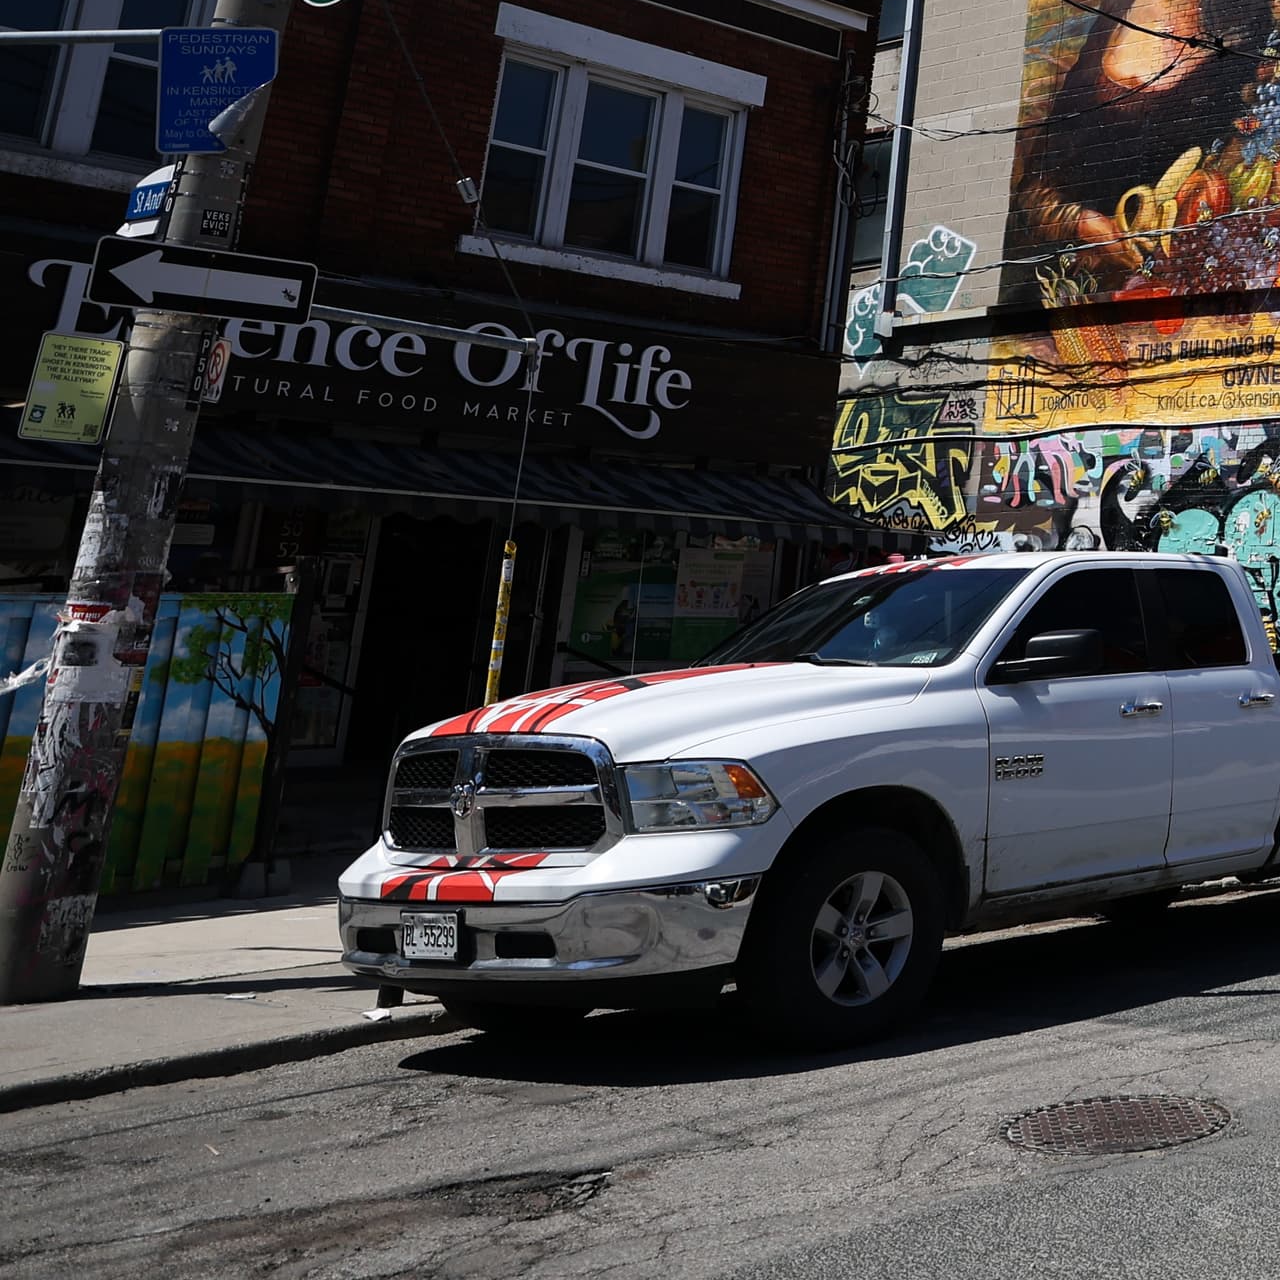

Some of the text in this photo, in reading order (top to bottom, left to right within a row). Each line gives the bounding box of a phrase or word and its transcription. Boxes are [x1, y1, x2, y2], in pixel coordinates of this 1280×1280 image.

[168, 34, 270, 44] PEDESTRIAN
[181, 45, 257, 55] SUNDAYS
[167, 86, 260, 96] IN KENSINGT
[190, 97, 238, 107] MARKE
[202, 220, 229, 231] EVICT
[29, 259, 692, 439] Eence Of Life
[1138, 341, 1172, 363] THIS
[1179, 336, 1255, 362] BUILDING
[1258, 334, 1275, 355] IS
[232, 375, 572, 427] TURAL FOOD MARKET
[1041, 393, 1089, 410] TORONTO
[405, 924, 455, 949] BL 55299
